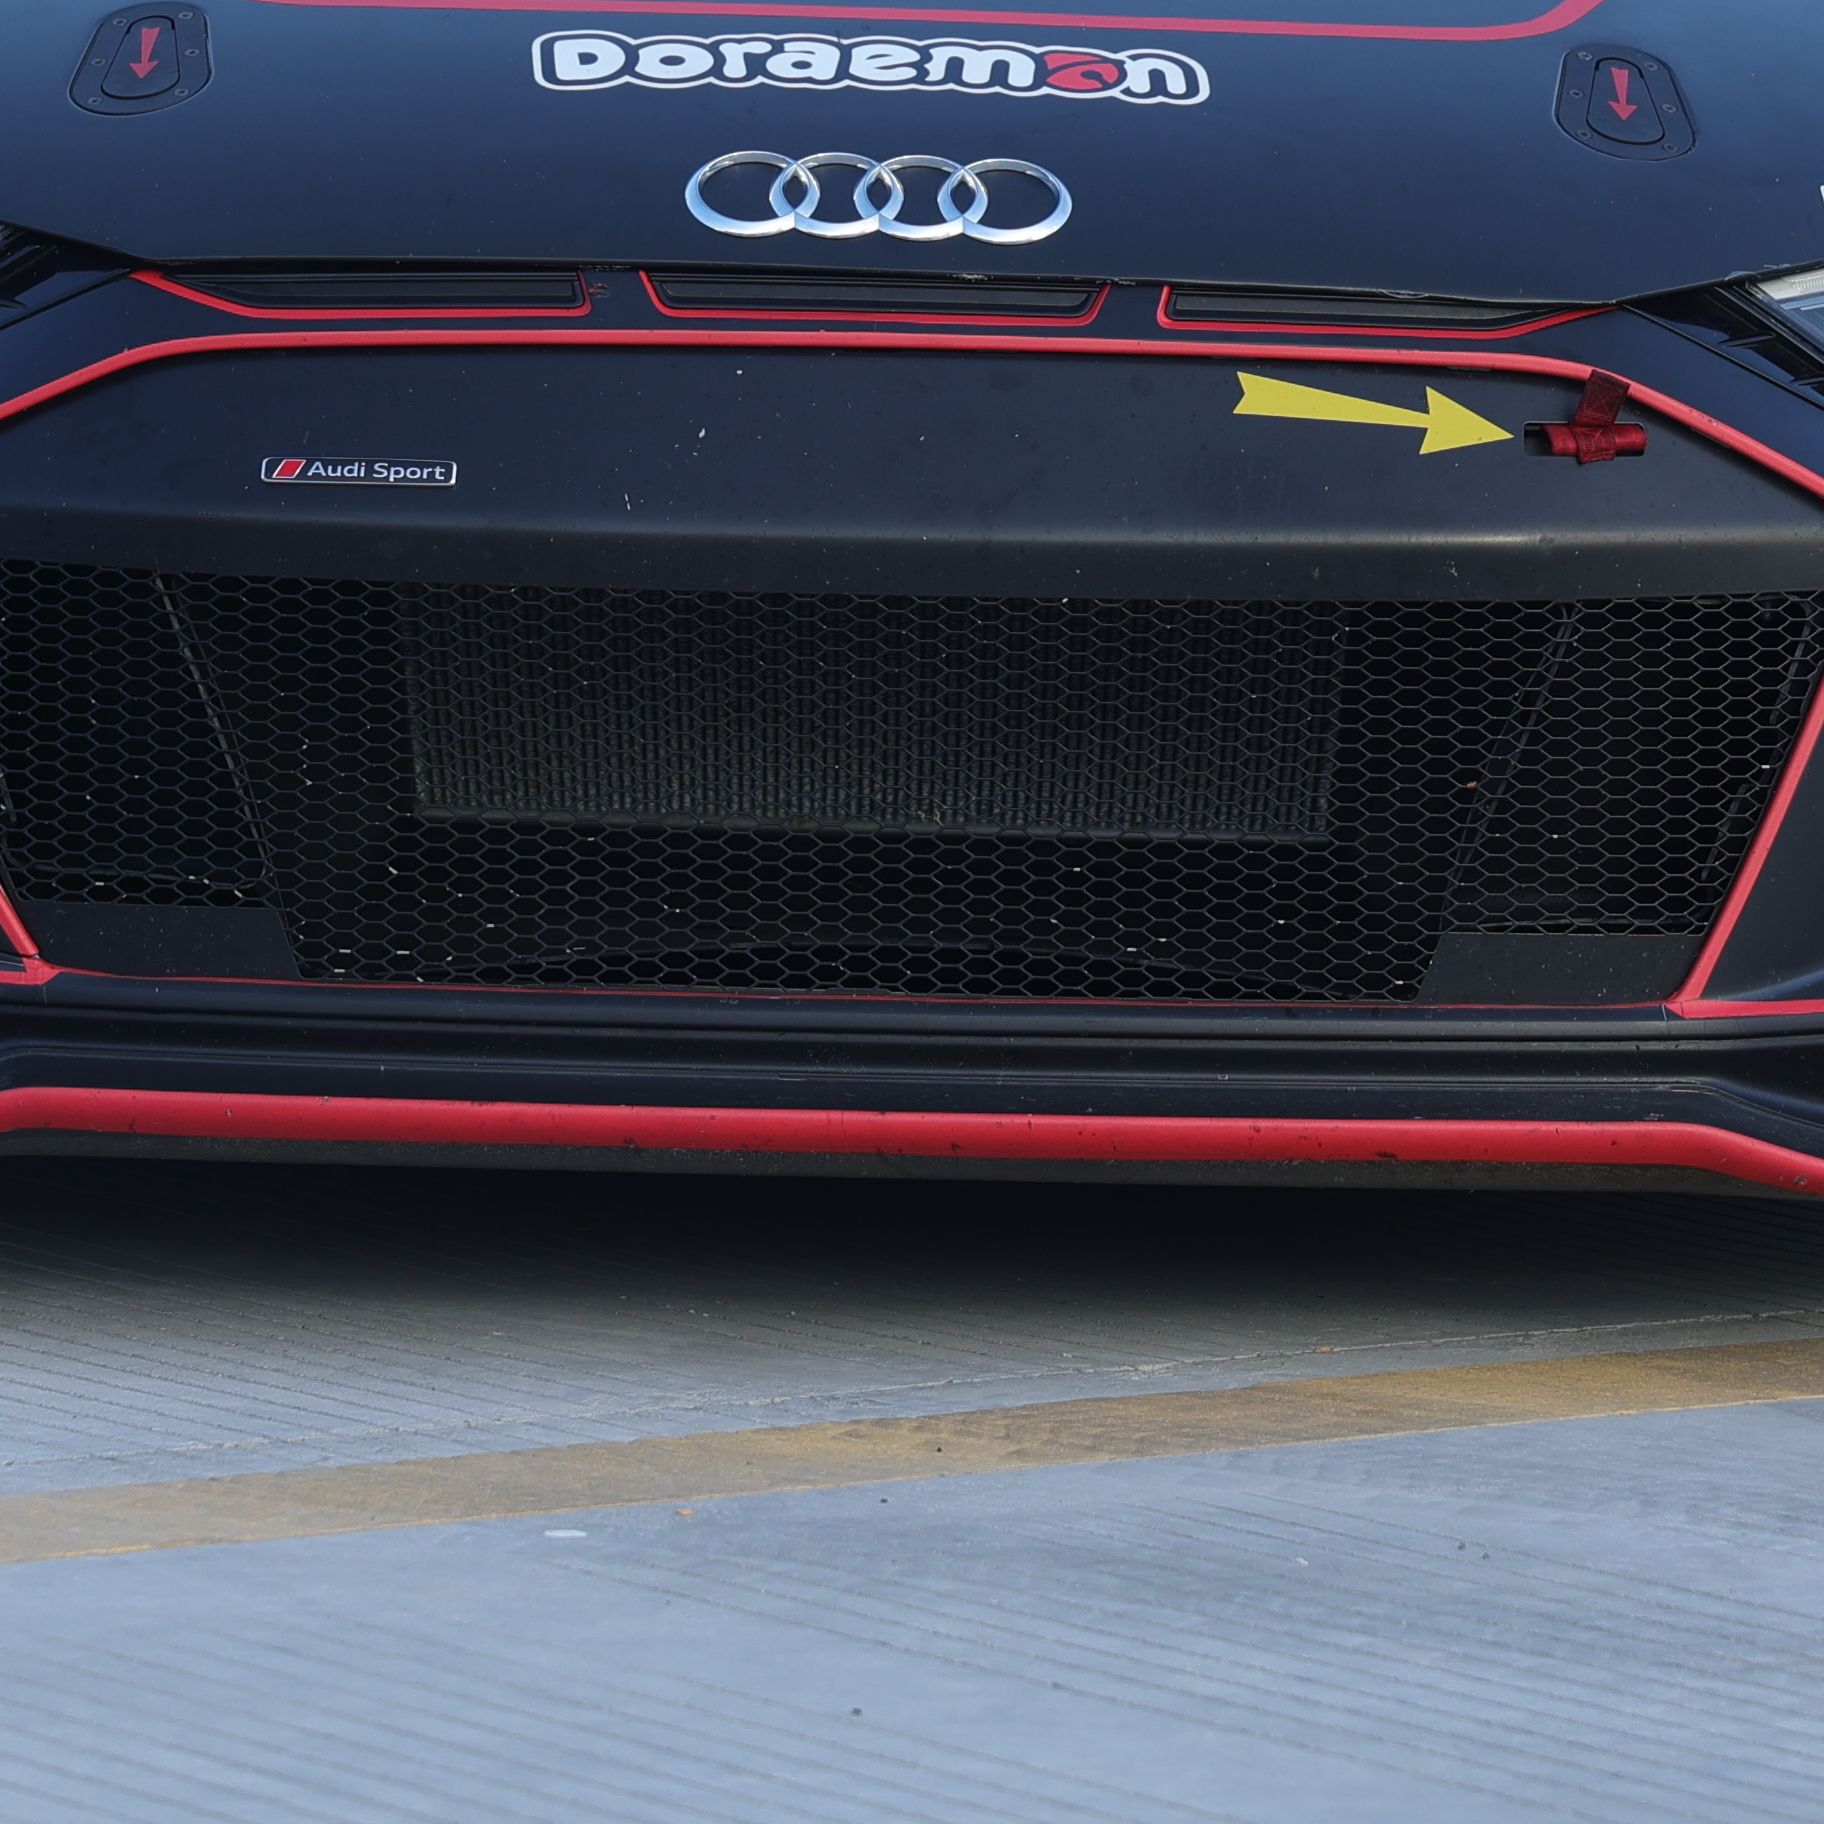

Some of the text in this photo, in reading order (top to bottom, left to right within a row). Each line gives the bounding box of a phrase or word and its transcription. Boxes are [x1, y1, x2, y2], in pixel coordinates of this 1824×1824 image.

[532, 30, 1210, 104] Doraemon
[307, 461, 446, 482] Audi Sport
